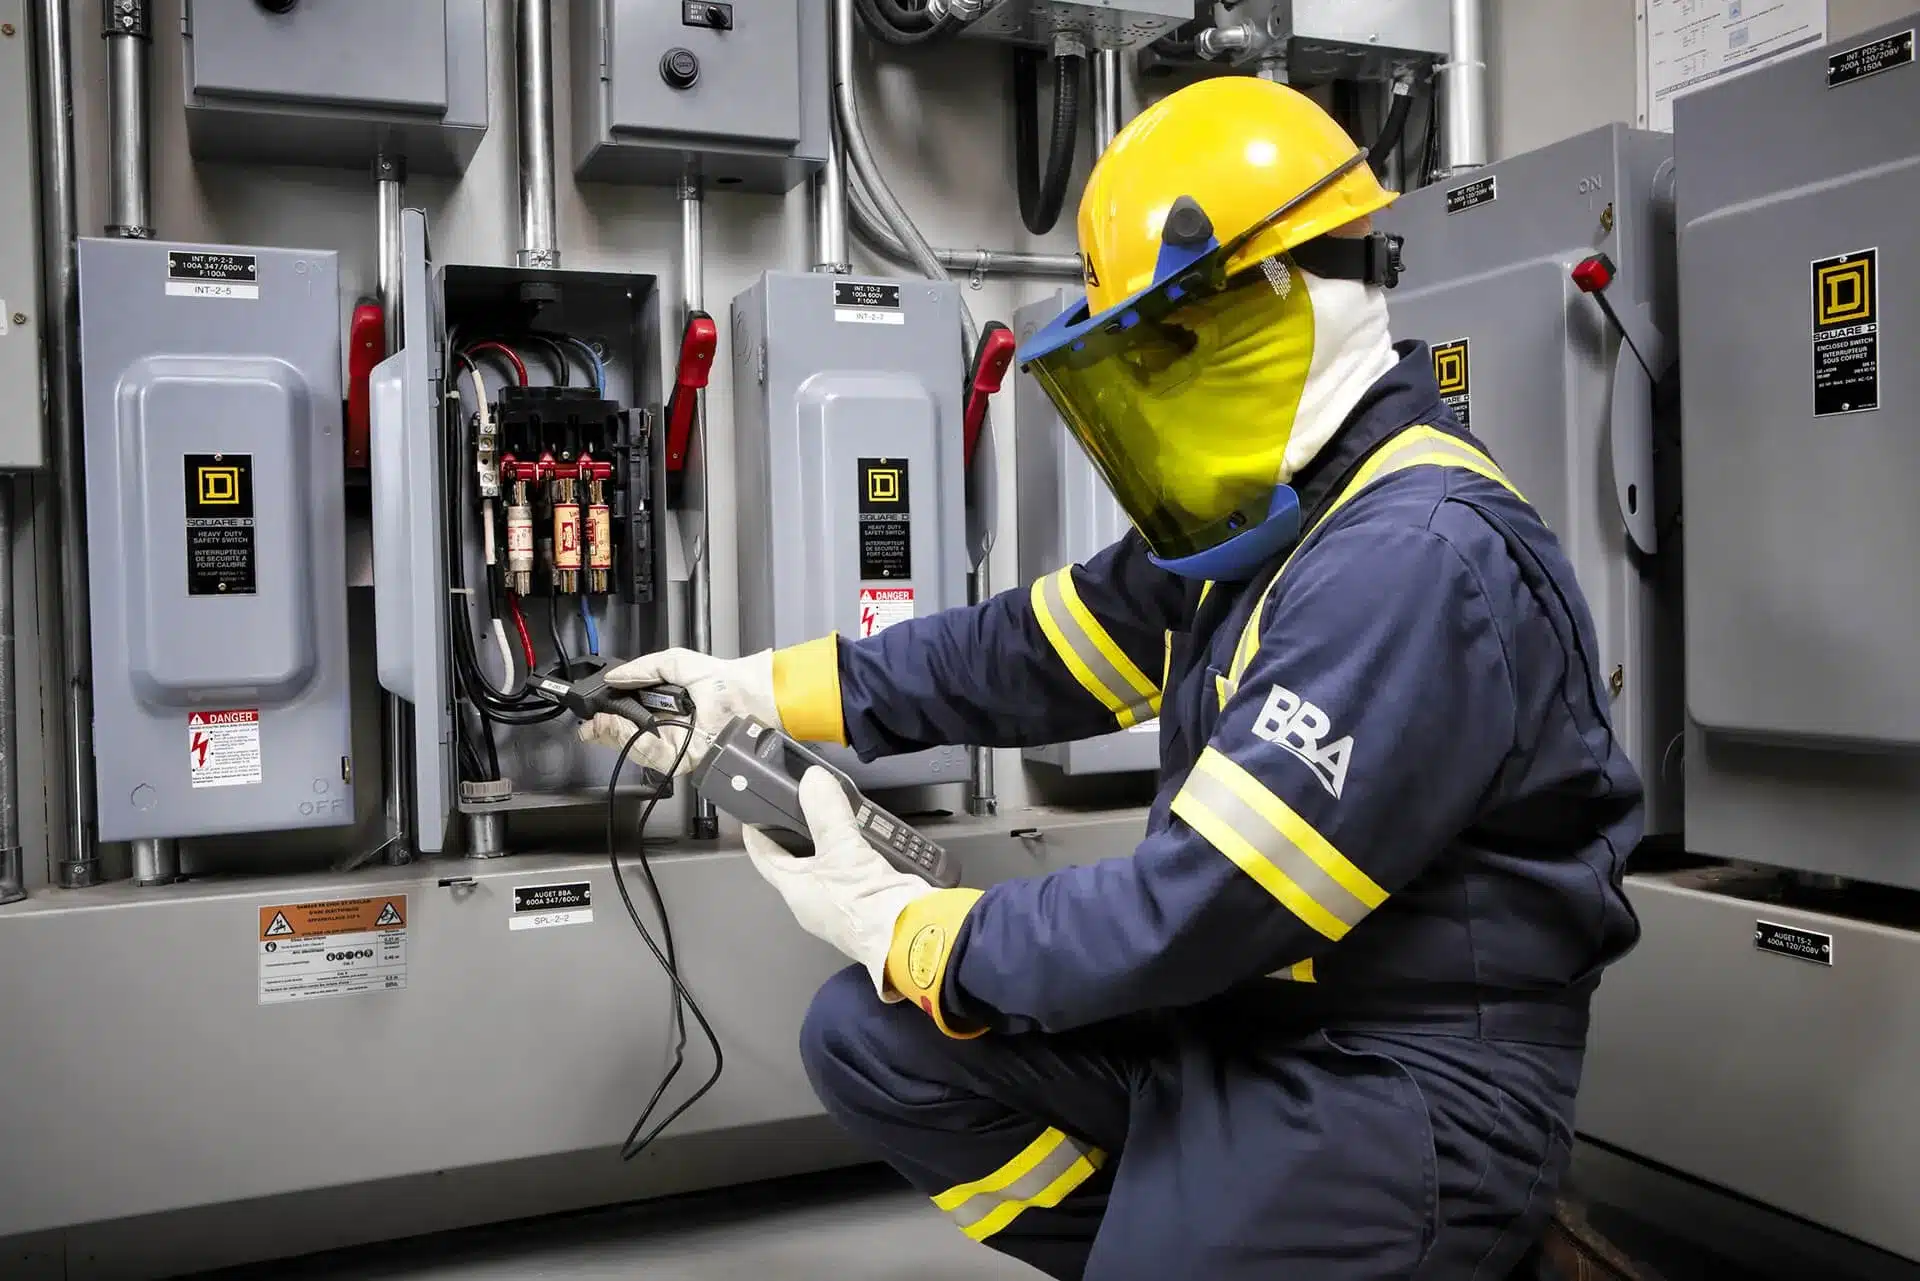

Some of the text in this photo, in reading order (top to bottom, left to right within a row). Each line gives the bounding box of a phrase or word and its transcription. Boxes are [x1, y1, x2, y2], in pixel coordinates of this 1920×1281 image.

[1840, 46, 1900, 72] 200A 120/208V
[204, 263, 243, 272] 347/600V
[194, 286, 232, 295] INT-2-5
[1814, 323, 1877, 341] SQUARE D
[1817, 337, 1874, 352] ENCLOSED SWITCH
[1822, 346, 1868, 359] INTERRUPTEUR
[1822, 352, 1868, 365] SOUS COFFRET
[187, 518, 253, 526] SQUARE D
[876, 591, 910, 600] DANGER
[209, 712, 253, 724] DANGER
[1251, 683, 1354, 800] BBA
[299, 799, 345, 816] OFF
[526, 895, 580, 906] 600A 347/600V
[534, 915, 570, 925] SPL-2-2
[1774, 932, 1812, 946] AUGET TS-2
[1767, 937, 1819, 955] 400A 120/208V
